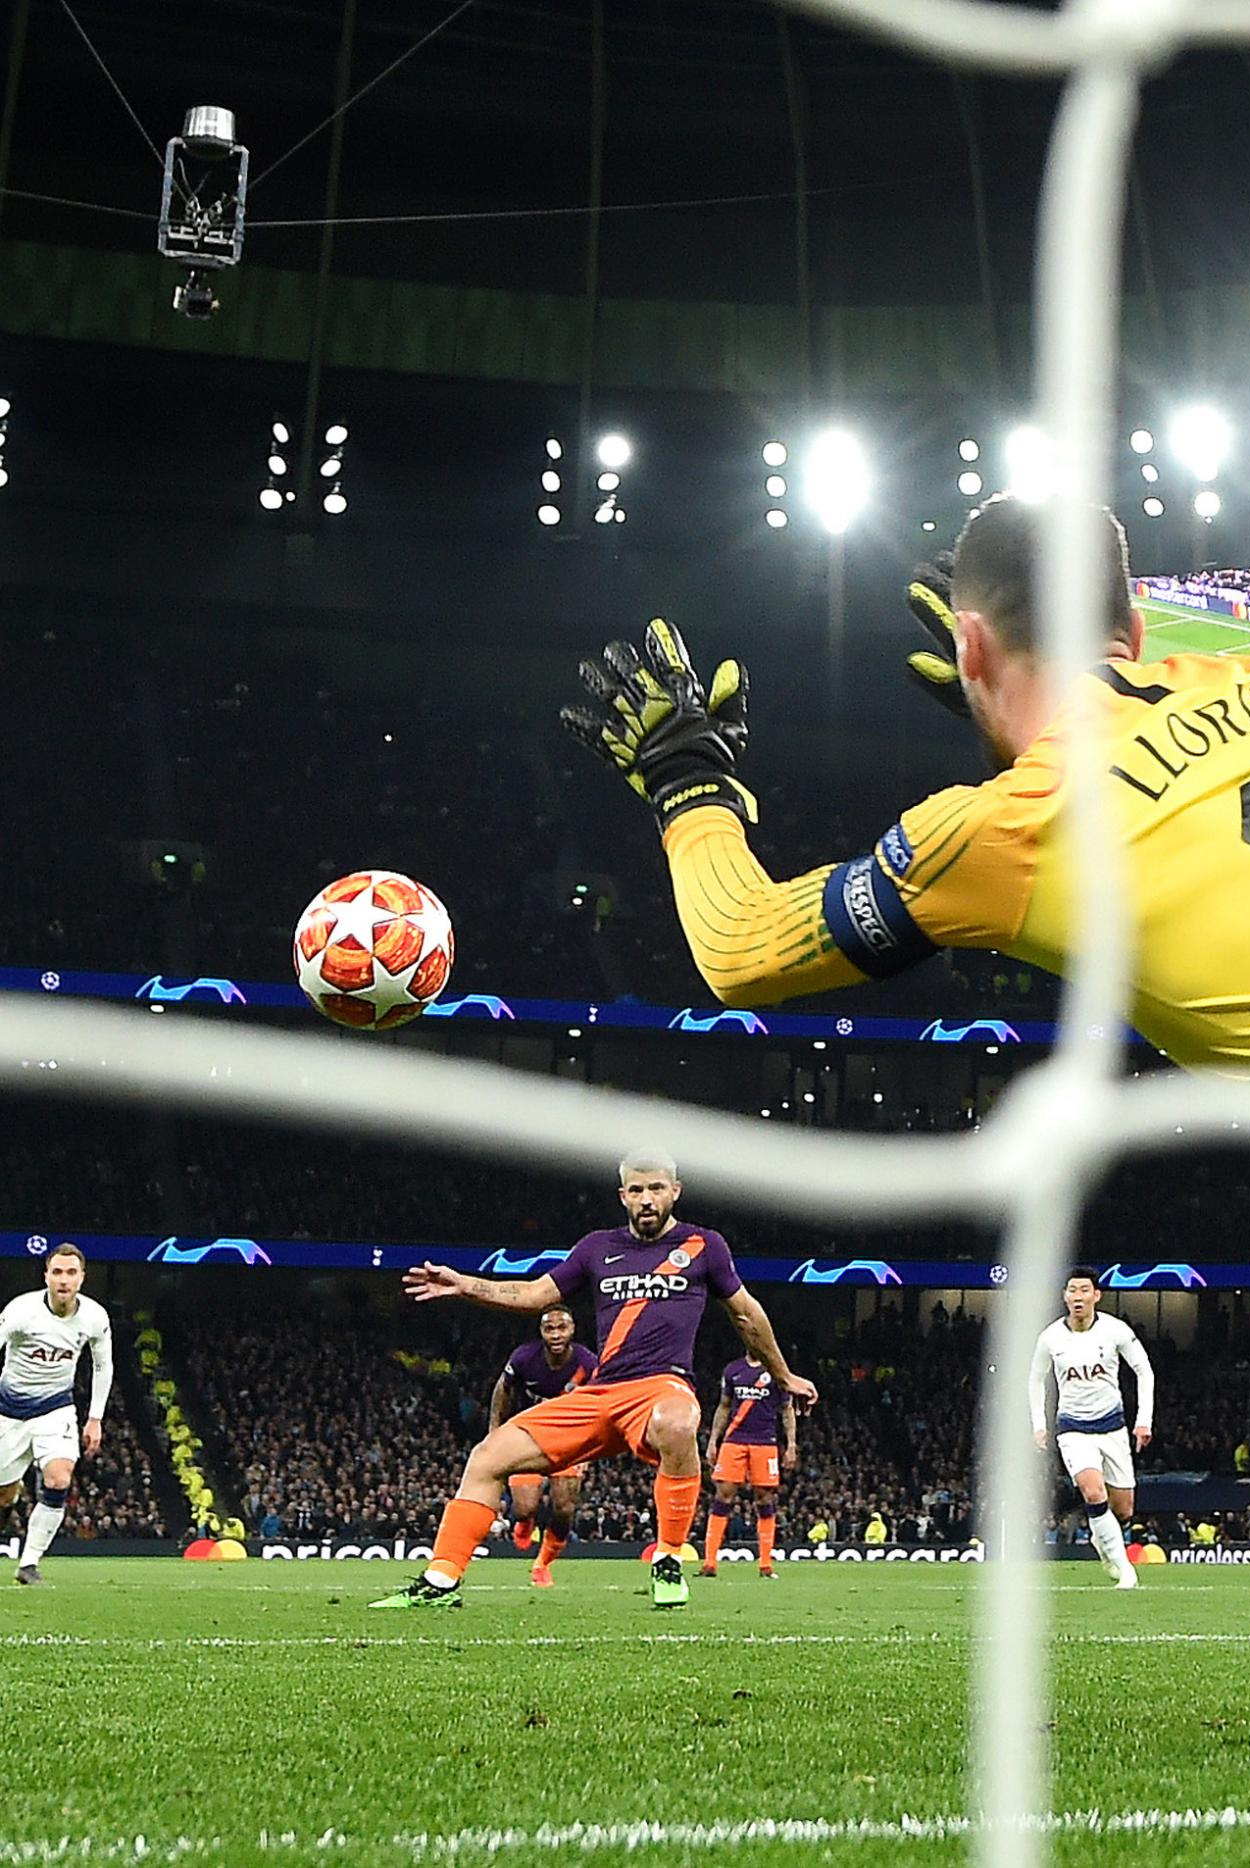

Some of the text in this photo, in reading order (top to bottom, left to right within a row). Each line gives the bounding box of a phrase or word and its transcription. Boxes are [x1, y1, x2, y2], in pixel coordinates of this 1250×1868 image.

[600, 1273, 688, 1293] ETIHAD
[612, 1288, 670, 1300] AIRWAYS
[31, 1348, 74, 1361] AIA
[1066, 1363, 1107, 1381] AIA
[262, 1539, 490, 1560] pricele
